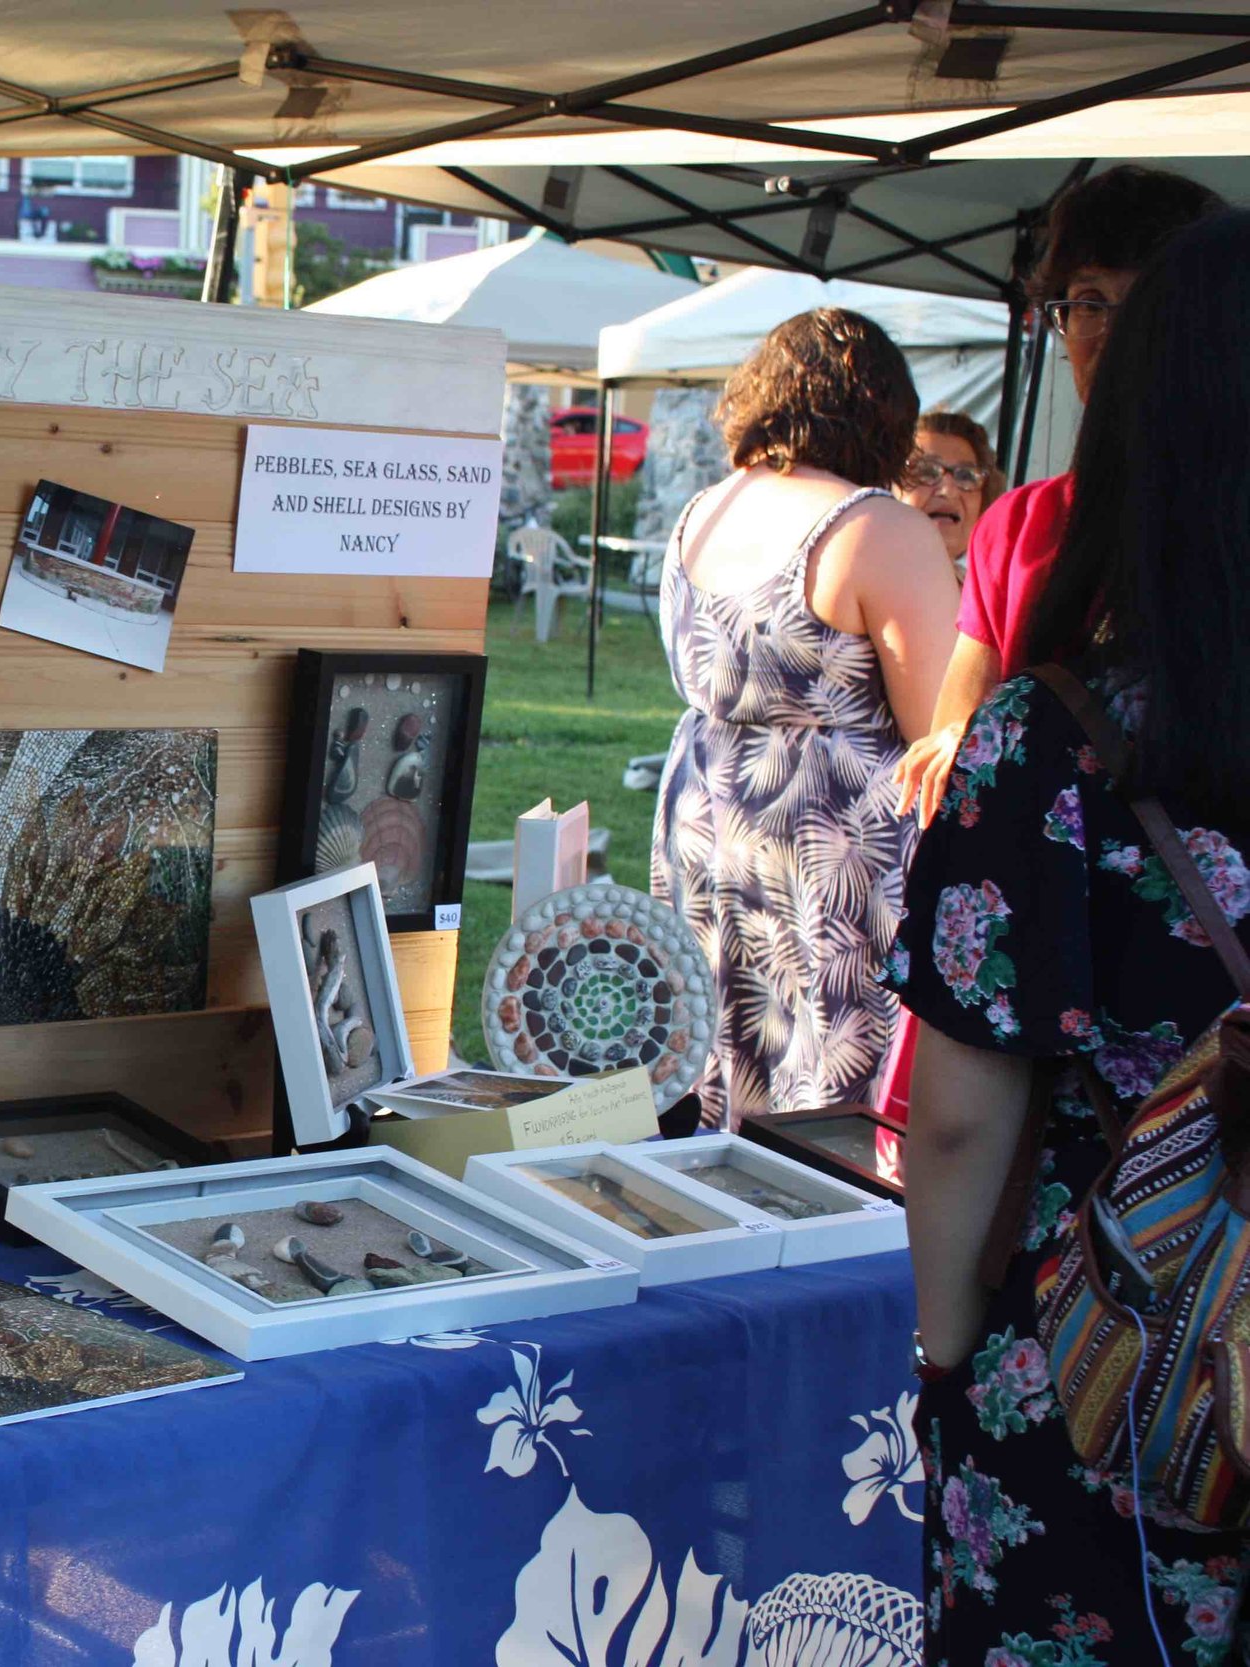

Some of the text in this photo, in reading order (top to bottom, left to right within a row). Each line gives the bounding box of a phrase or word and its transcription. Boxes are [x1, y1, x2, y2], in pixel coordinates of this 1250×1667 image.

[64, 338, 186, 410] THE
[200, 347, 321, 419] SEA
[254, 455, 492, 484] PEBBLES, SEA GLASS, SAND
[272, 494, 471, 520] AND SHELL DESIGNS BY
[340, 533, 400, 553] NANCY
[439, 912, 458, 924] $40
